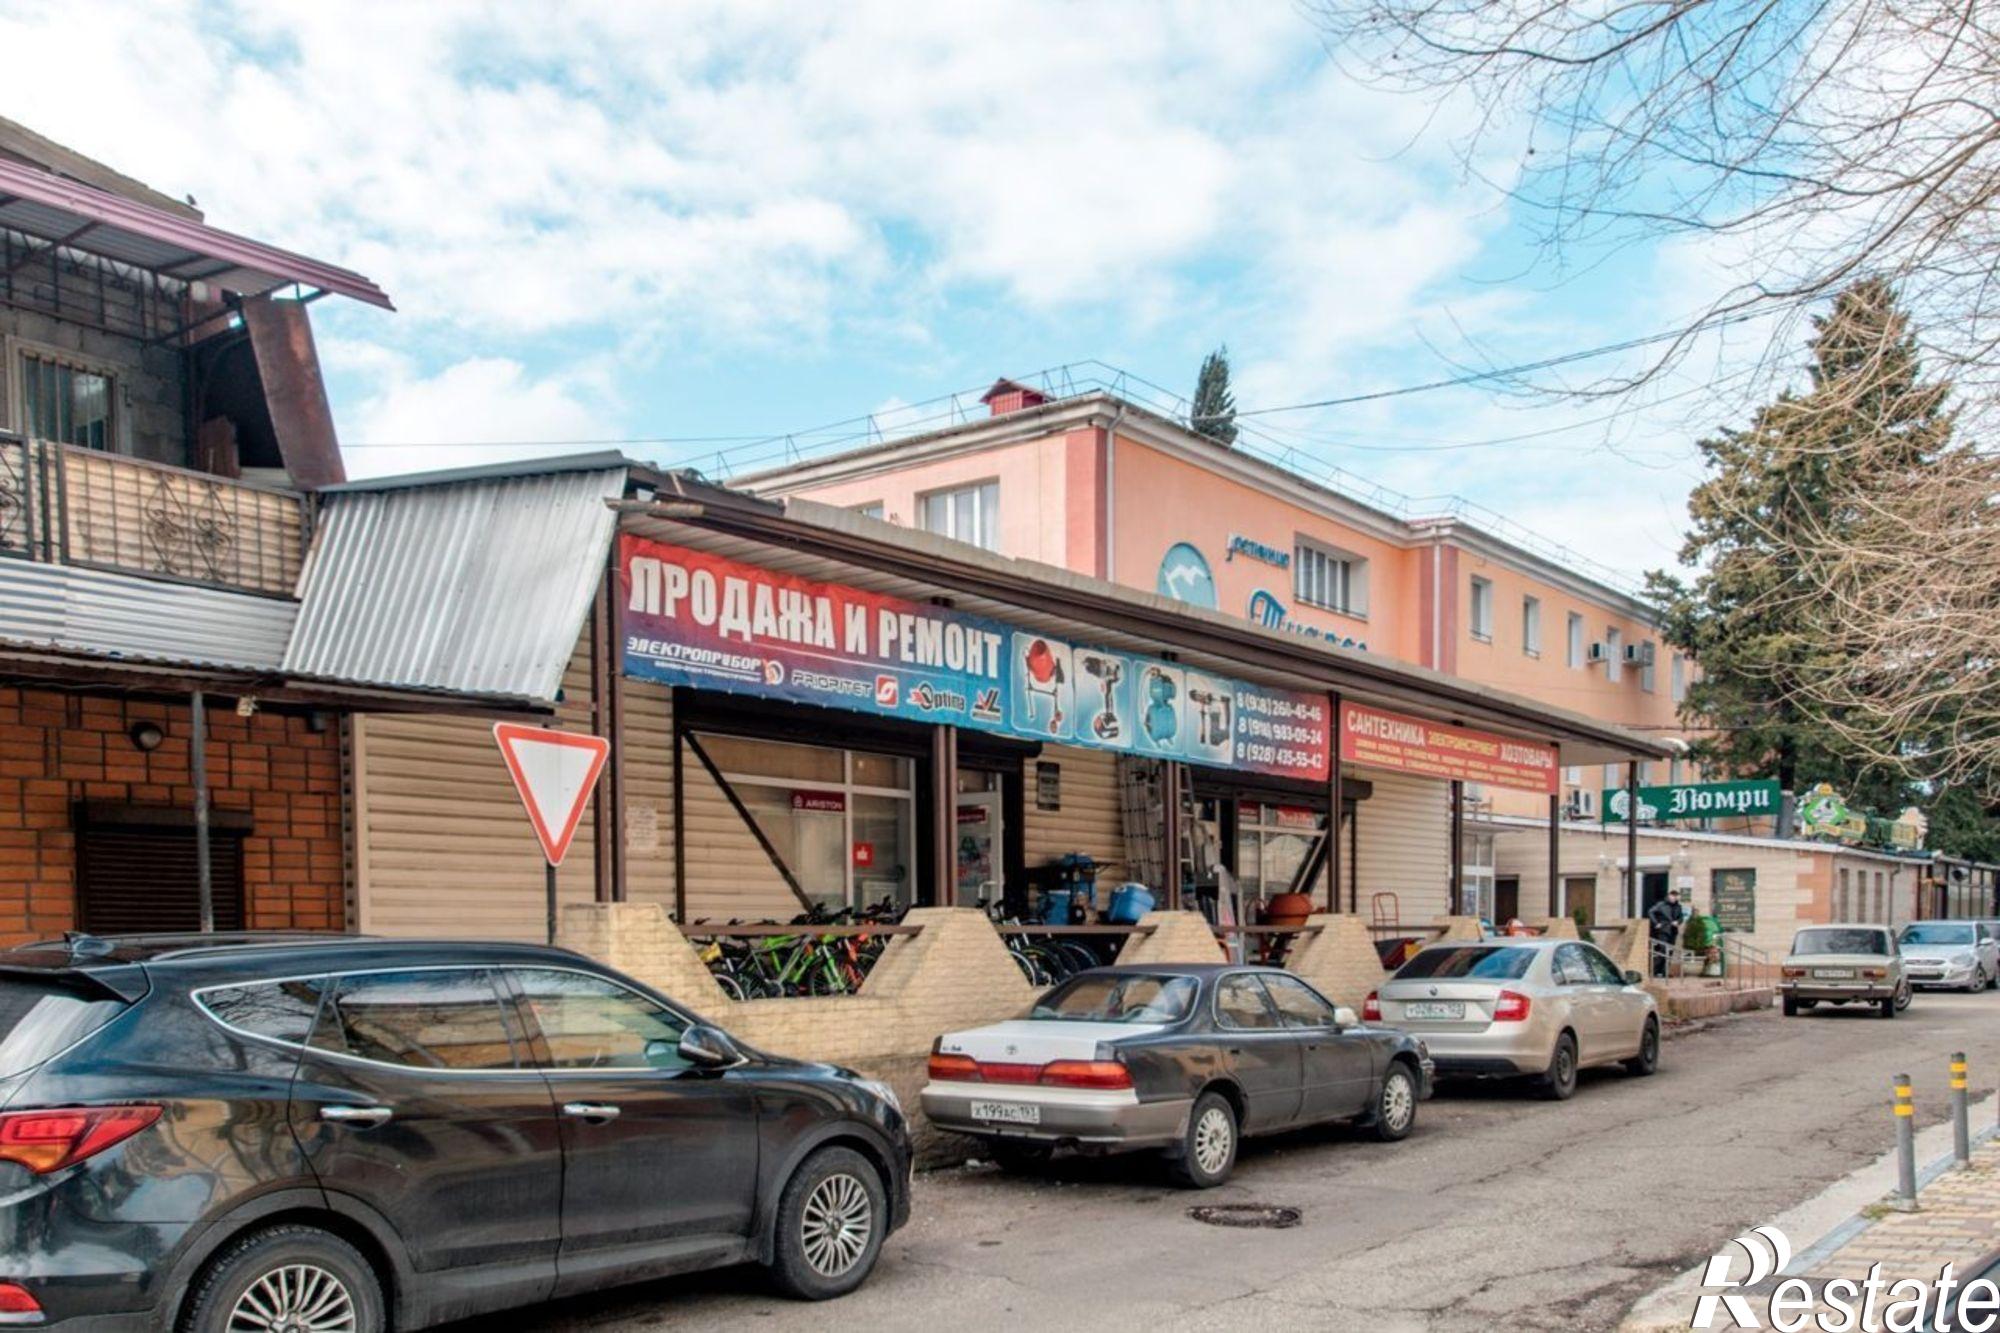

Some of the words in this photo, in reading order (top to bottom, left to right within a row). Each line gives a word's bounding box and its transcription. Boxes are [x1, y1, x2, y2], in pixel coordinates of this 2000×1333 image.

[628, 556, 836, 649] ПРОДАЖА
[844, 602, 867, 655] И
[878, 608, 1002, 679] РЕМОНТ
[627, 636, 762, 670] ЭЛЕКТРОПРИБОР
[791, 669, 873, 698] PRIORITET
[918, 681, 966, 712] Optima
[1236, 691, 1245, 708] 8
[1238, 716, 1247, 733] 8
[1347, 709, 1427, 747] САНТЕХНИКА
[1500, 742, 1553, 769] ХОЗТОВАРЫ
[1236, 742, 1245, 759] 8
[1246, 742, 1276, 765] (928)
[805, 799, 843, 810] ARISTON
